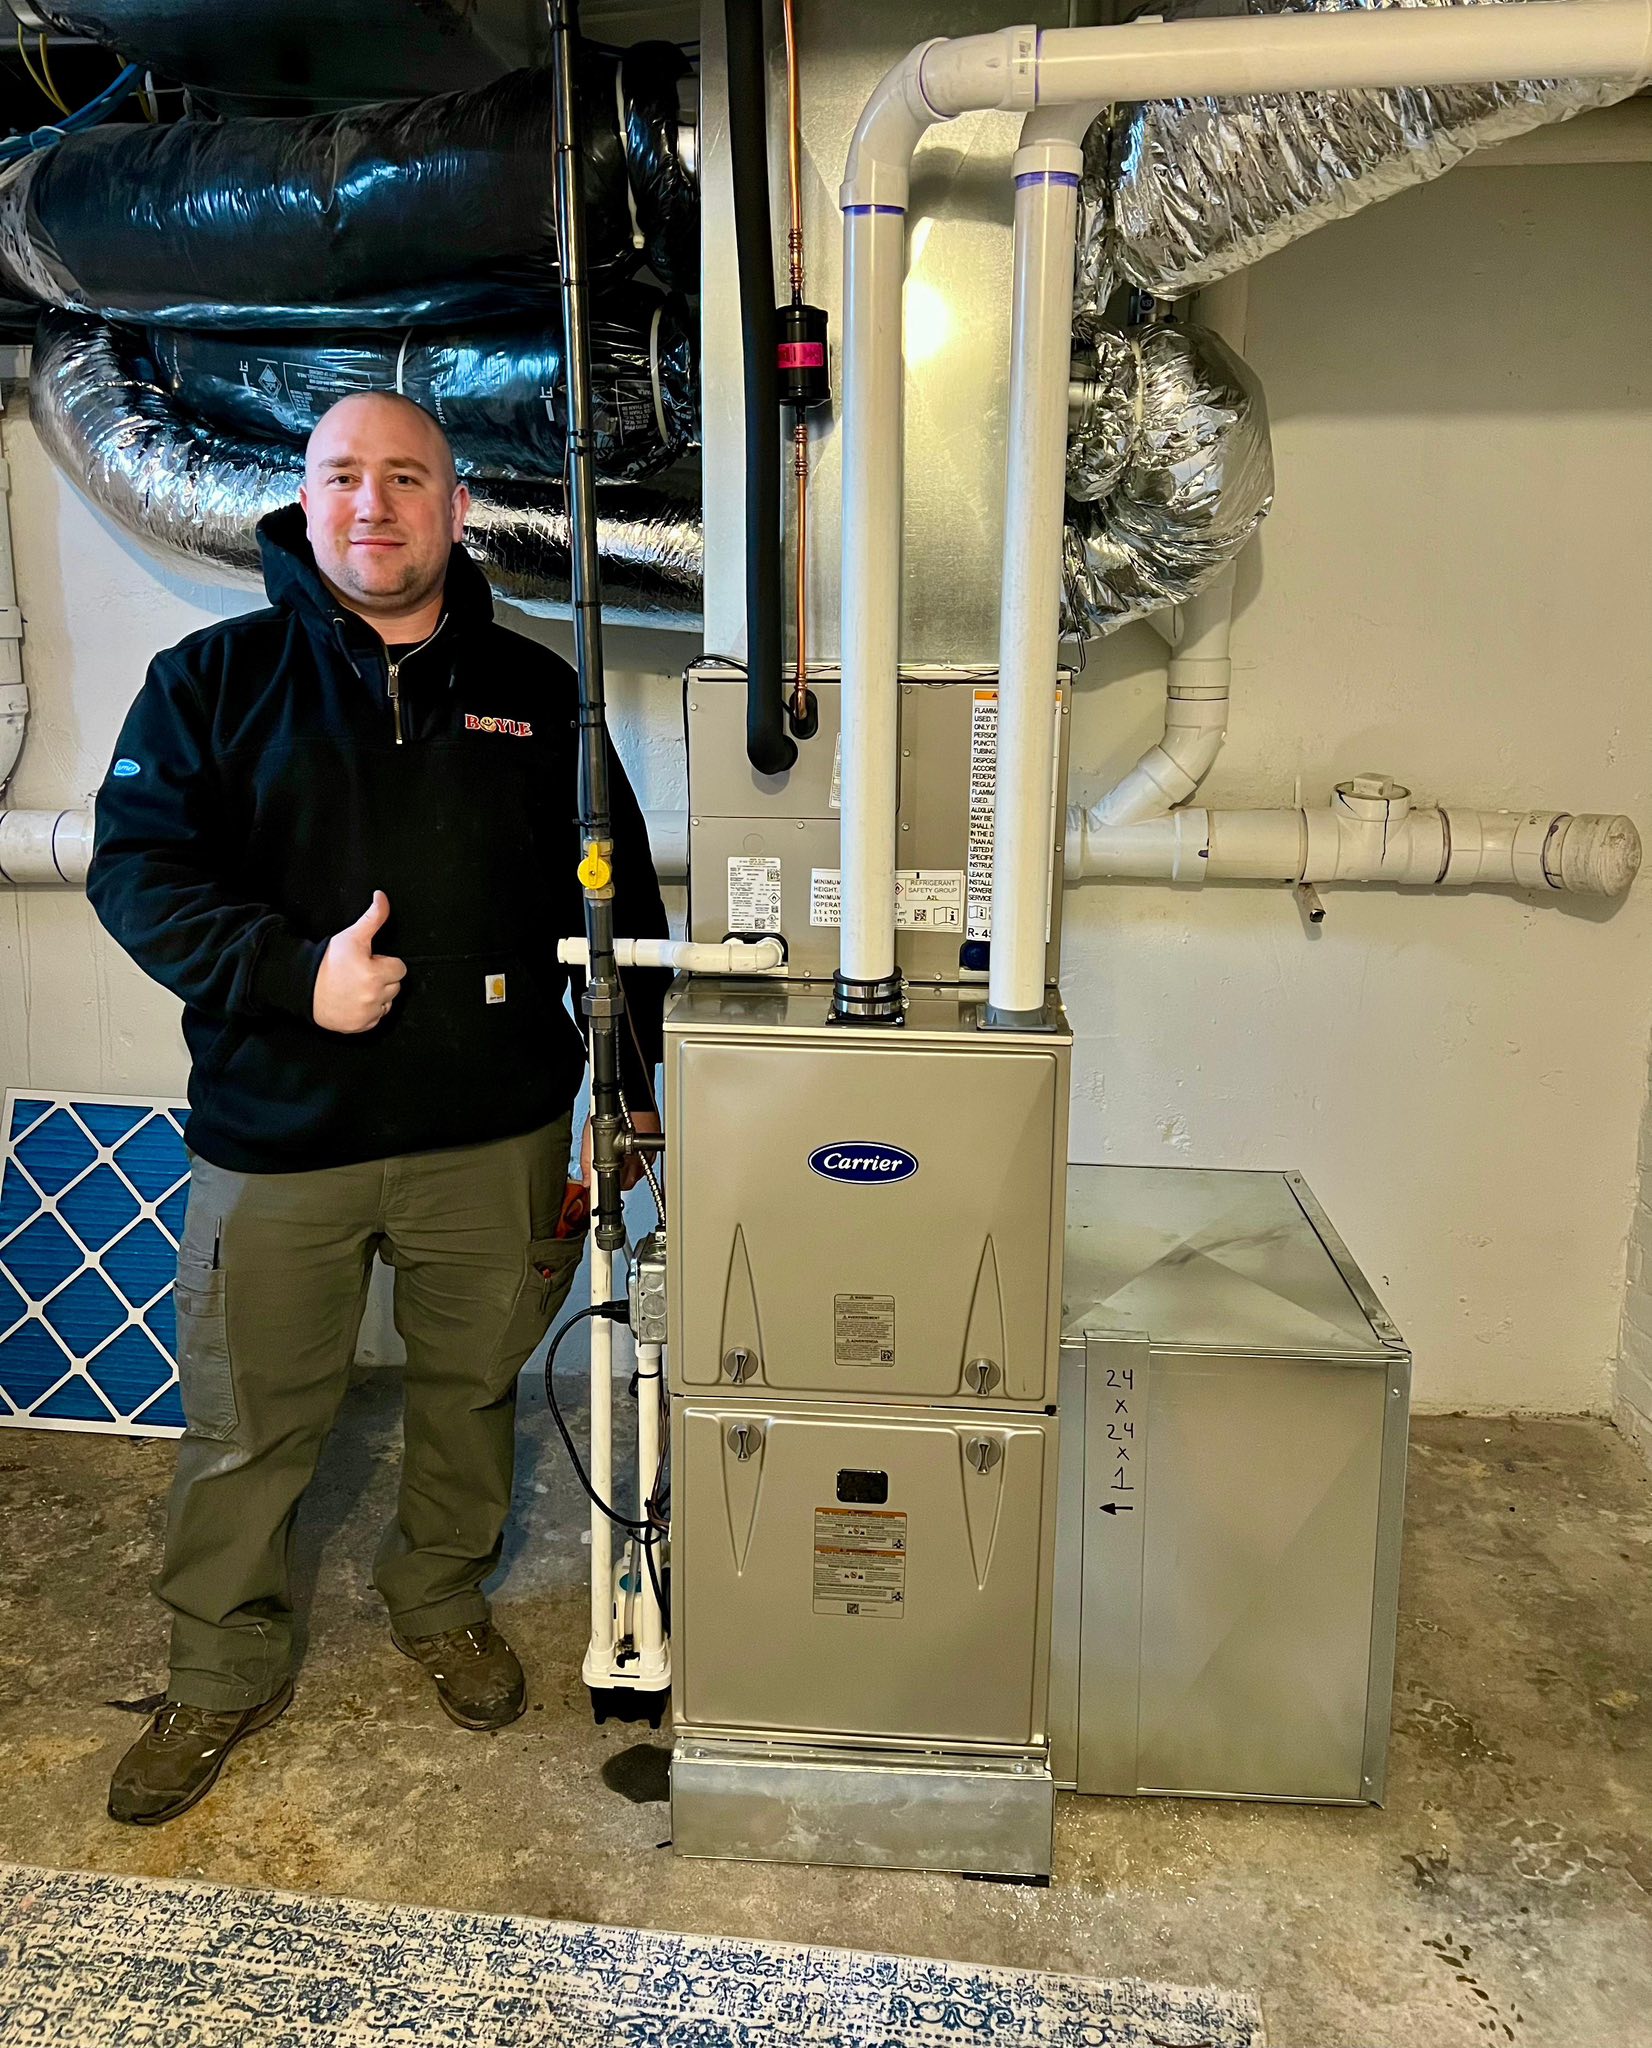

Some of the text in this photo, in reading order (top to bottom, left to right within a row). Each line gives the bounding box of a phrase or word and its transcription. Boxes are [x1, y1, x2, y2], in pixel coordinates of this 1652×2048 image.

[540, 386, 554, 399] FT
[823, 1152, 903, 1172] Carrier
[1106, 1369, 1133, 1390] 24
[1106, 1422, 1134, 1440] 24
[1111, 1466, 1134, 1490] 1
